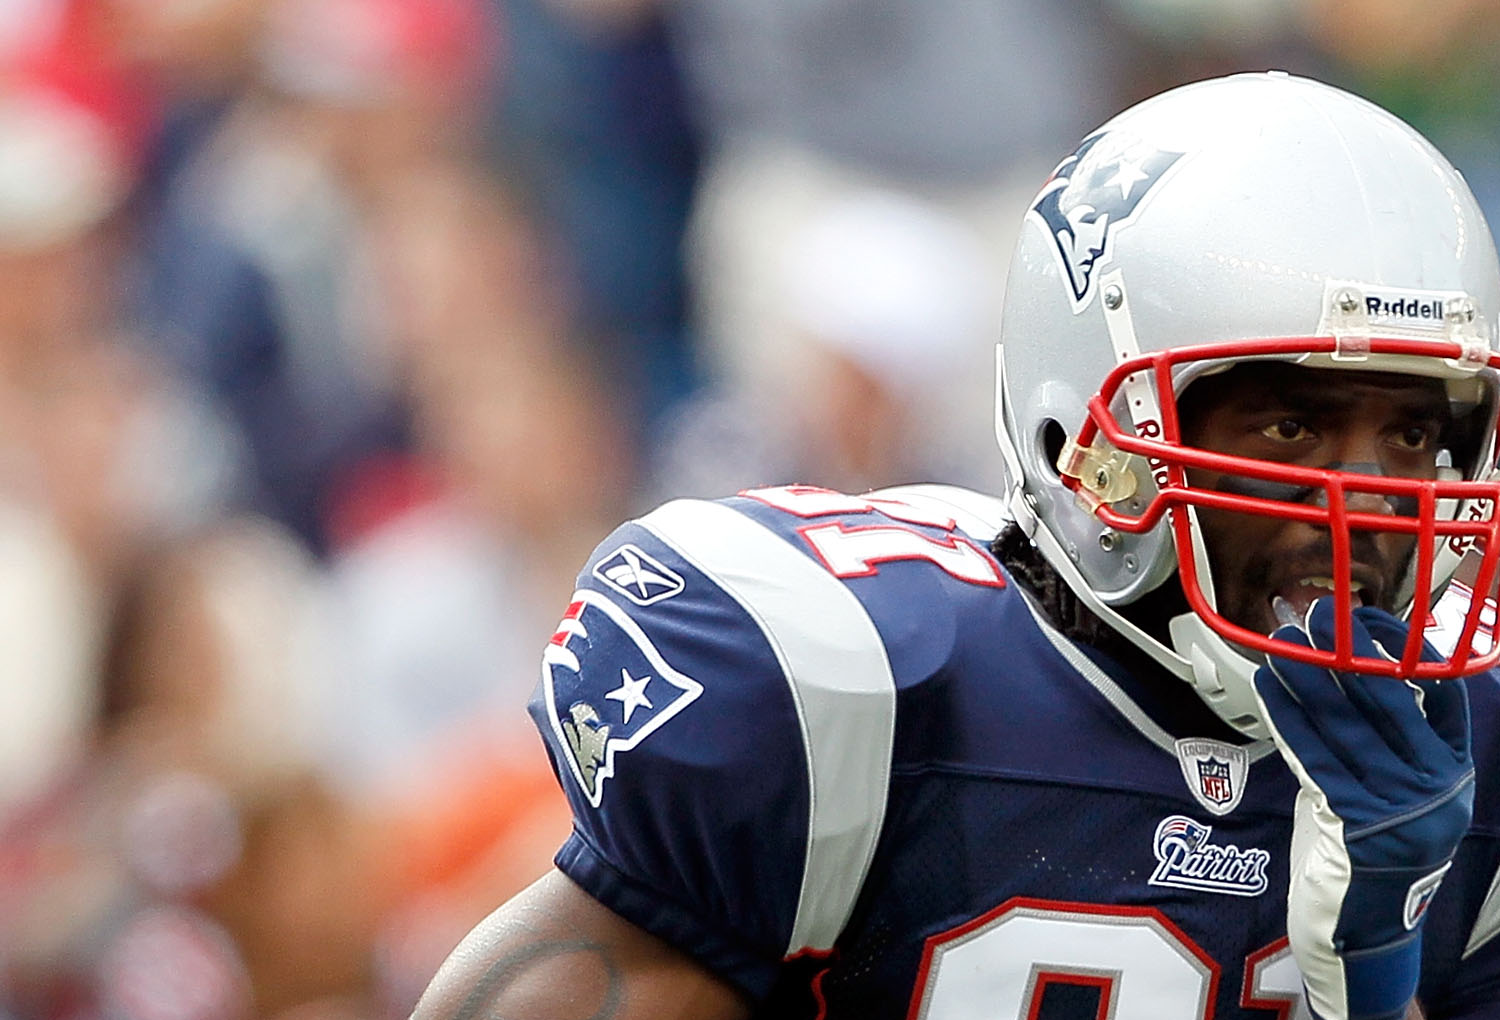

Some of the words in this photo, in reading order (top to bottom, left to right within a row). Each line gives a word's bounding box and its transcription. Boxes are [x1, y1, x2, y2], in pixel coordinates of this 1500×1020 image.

[1365, 296, 1443, 320] Riddell
[1202, 776, 1231, 800] NFL
[1153, 834, 1267, 885] Patriots
